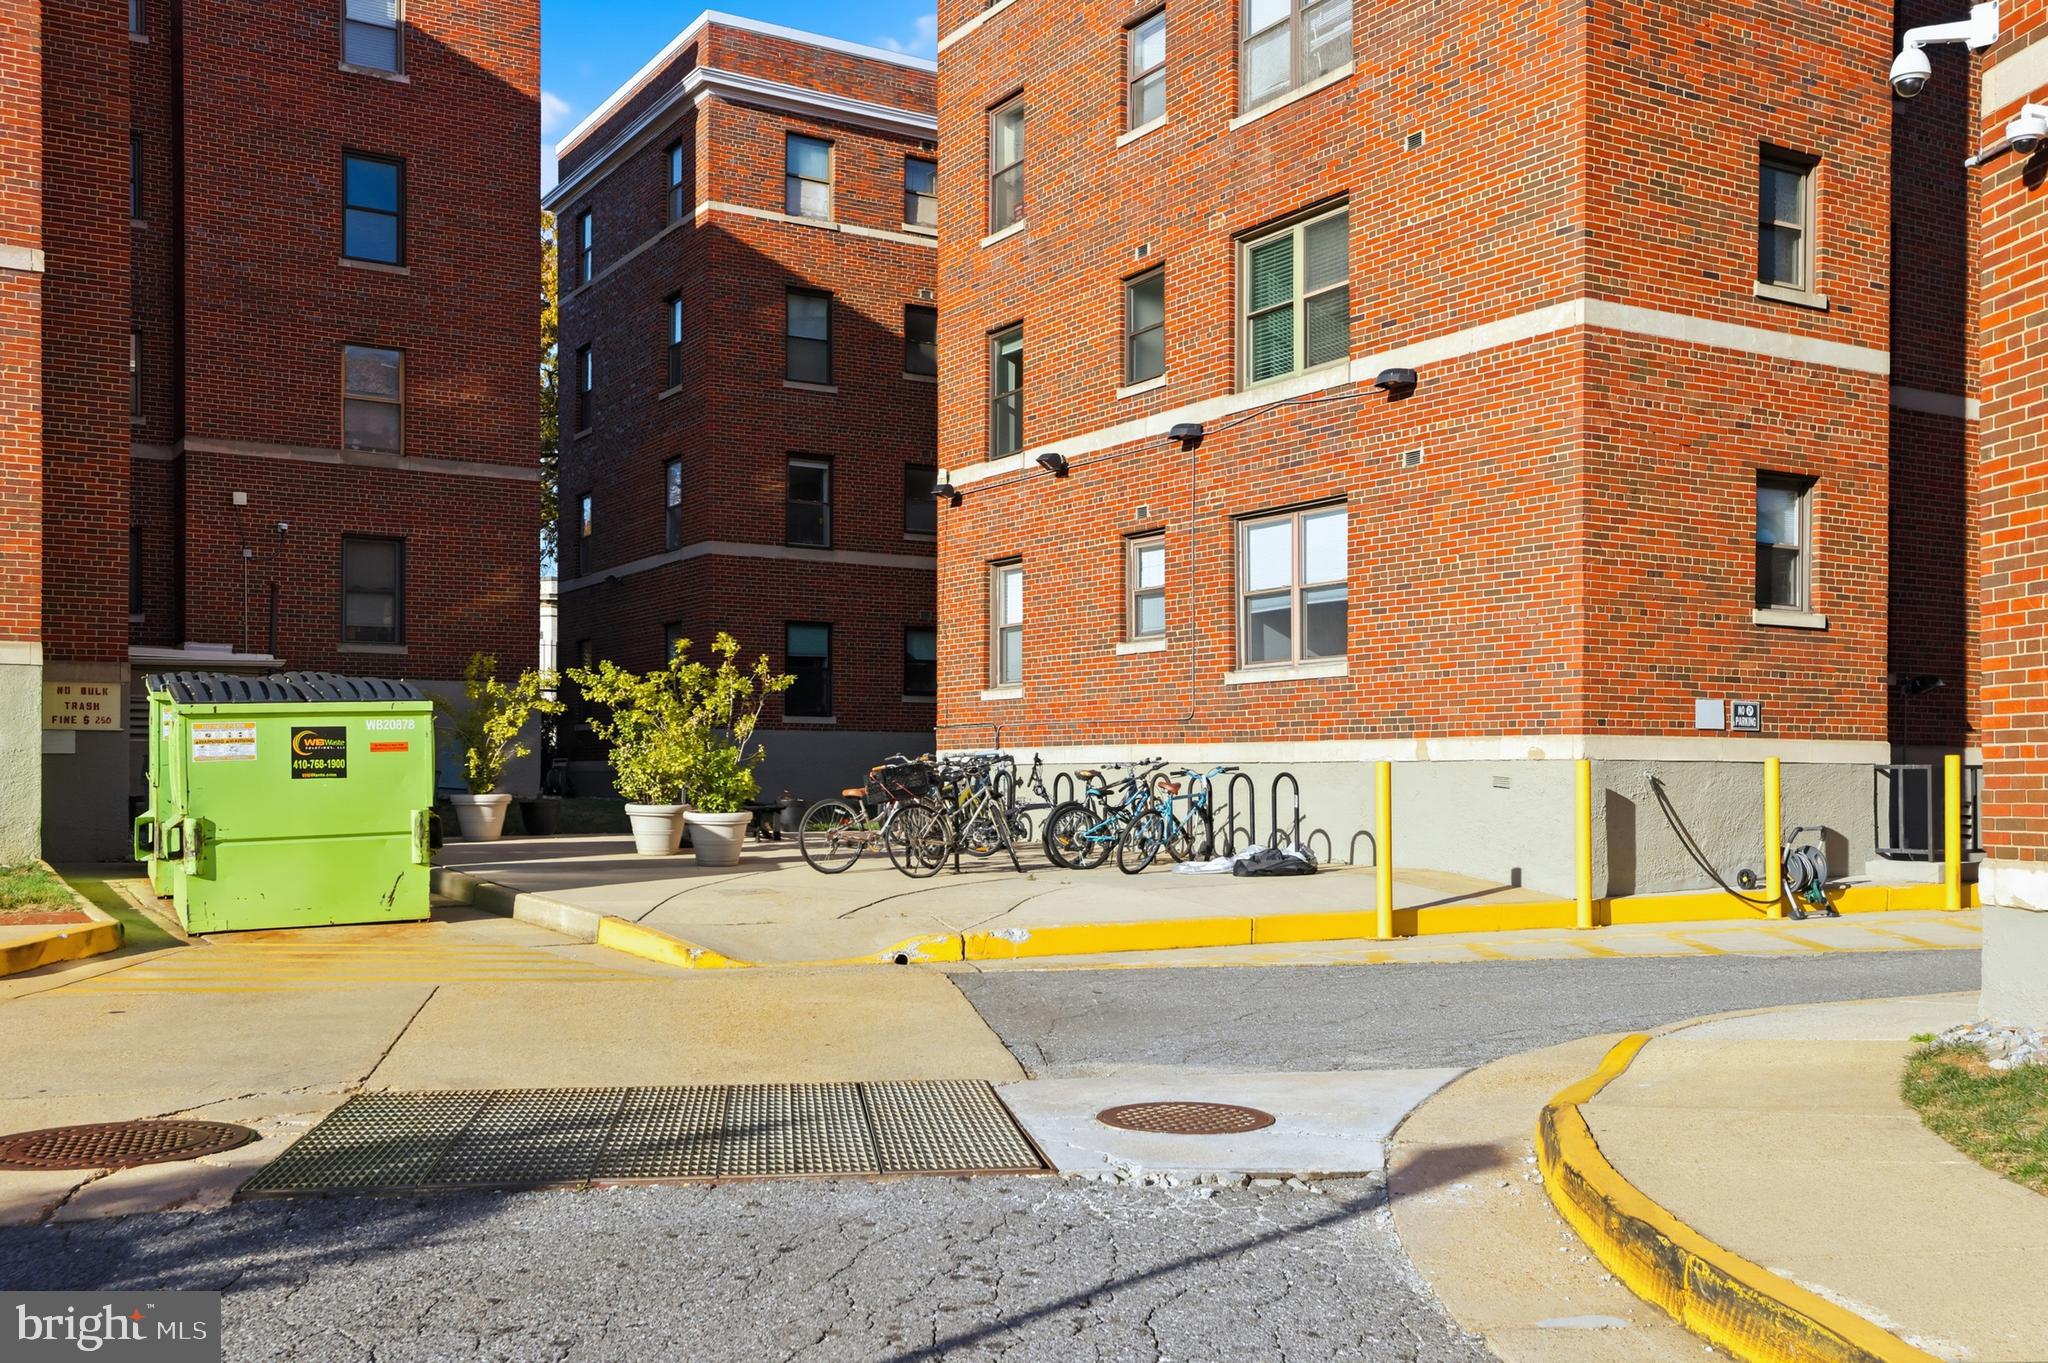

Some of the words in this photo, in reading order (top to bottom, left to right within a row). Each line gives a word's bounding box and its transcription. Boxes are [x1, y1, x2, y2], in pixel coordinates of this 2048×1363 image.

[57, 686, 71, 695] NO
[80, 687, 108, 696] BULK
[64, 702, 100, 711] TRASH
[1737, 705, 1745, 716] NO
[51, 716, 77, 724] FINE
[95, 716, 112, 725] 250
[366, 719, 416, 730] WB20878
[1735, 716, 1756, 727] PARKING
[293, 759, 346, 769] 410-768-1900
